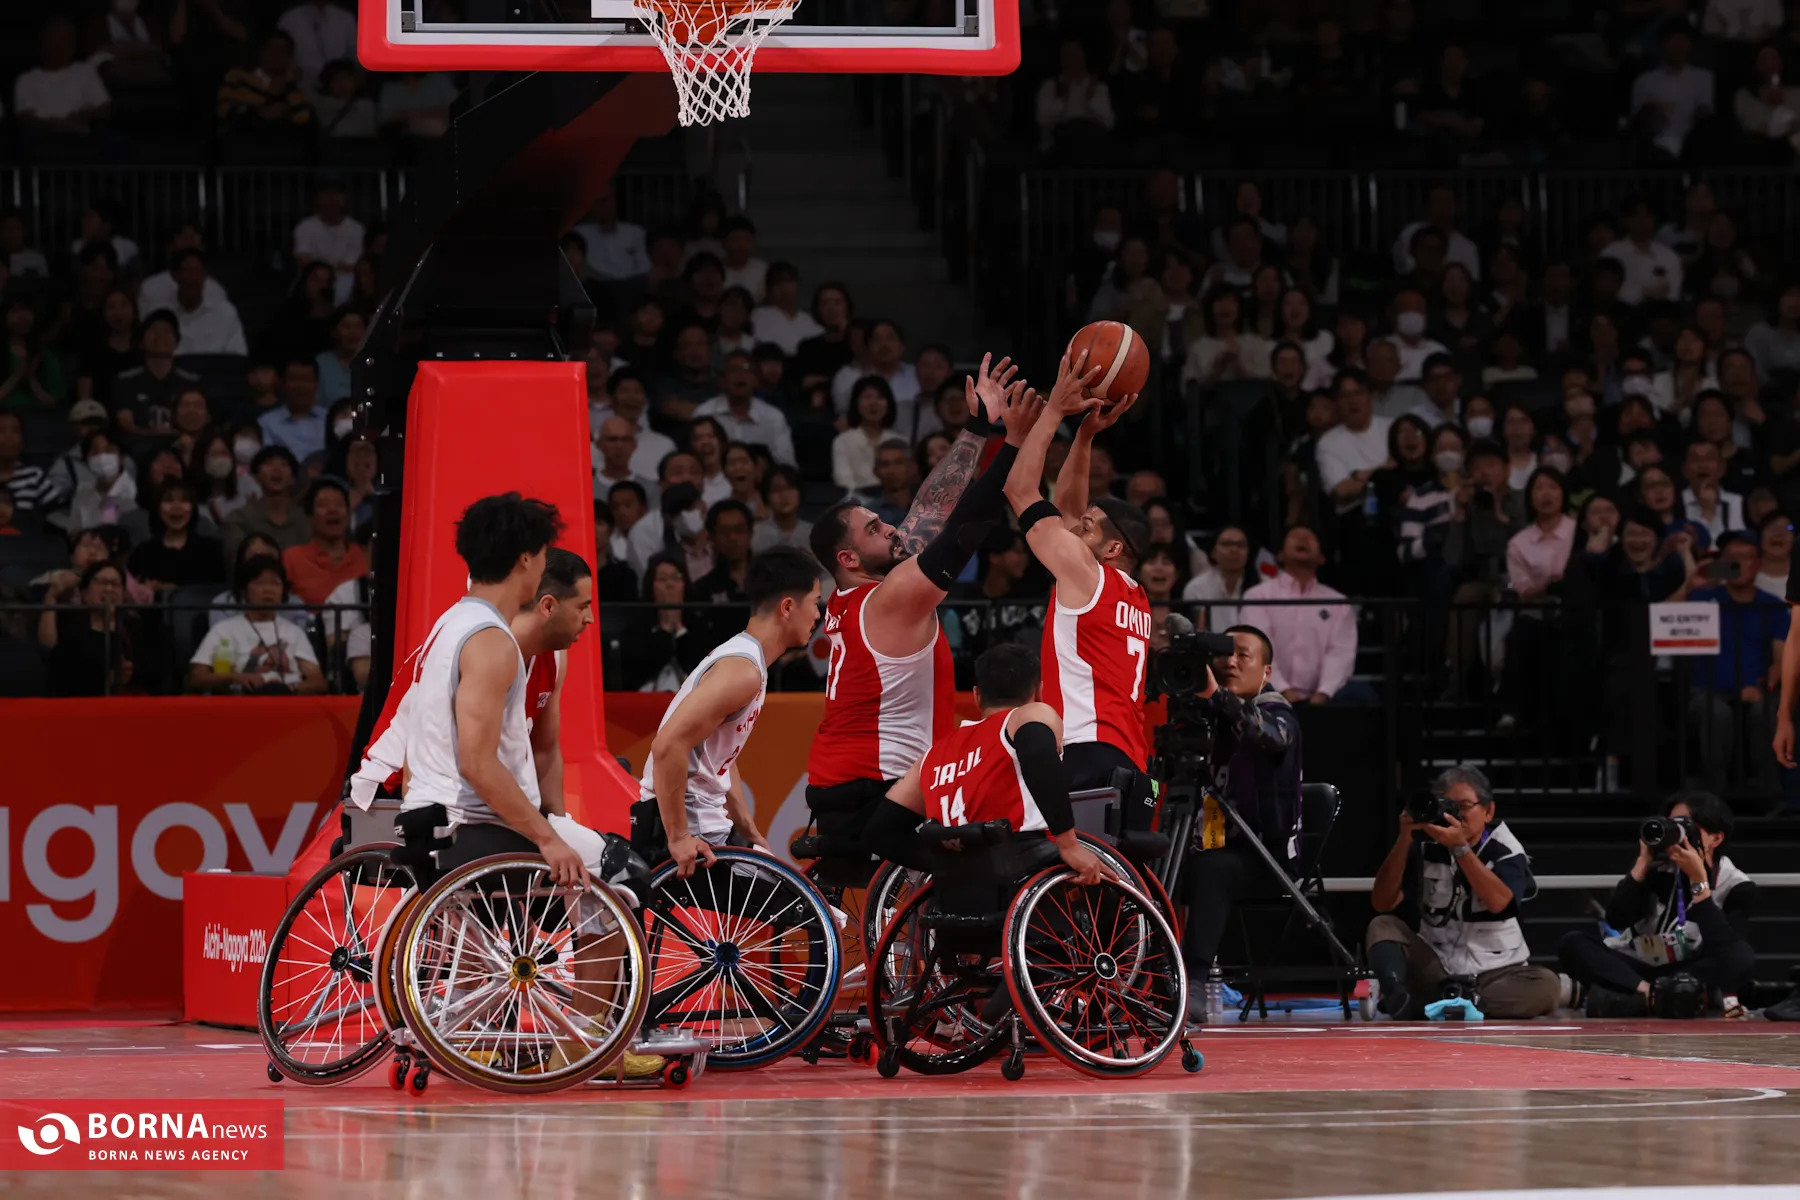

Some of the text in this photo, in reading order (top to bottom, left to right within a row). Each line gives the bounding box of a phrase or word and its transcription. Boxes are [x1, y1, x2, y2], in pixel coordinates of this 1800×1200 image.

[1115, 601, 1151, 639] OMID
[1126, 635, 1145, 702] 7
[940, 785, 968, 827] 14
[203, 922, 267, 973] Aichi-Nagoya 2026
